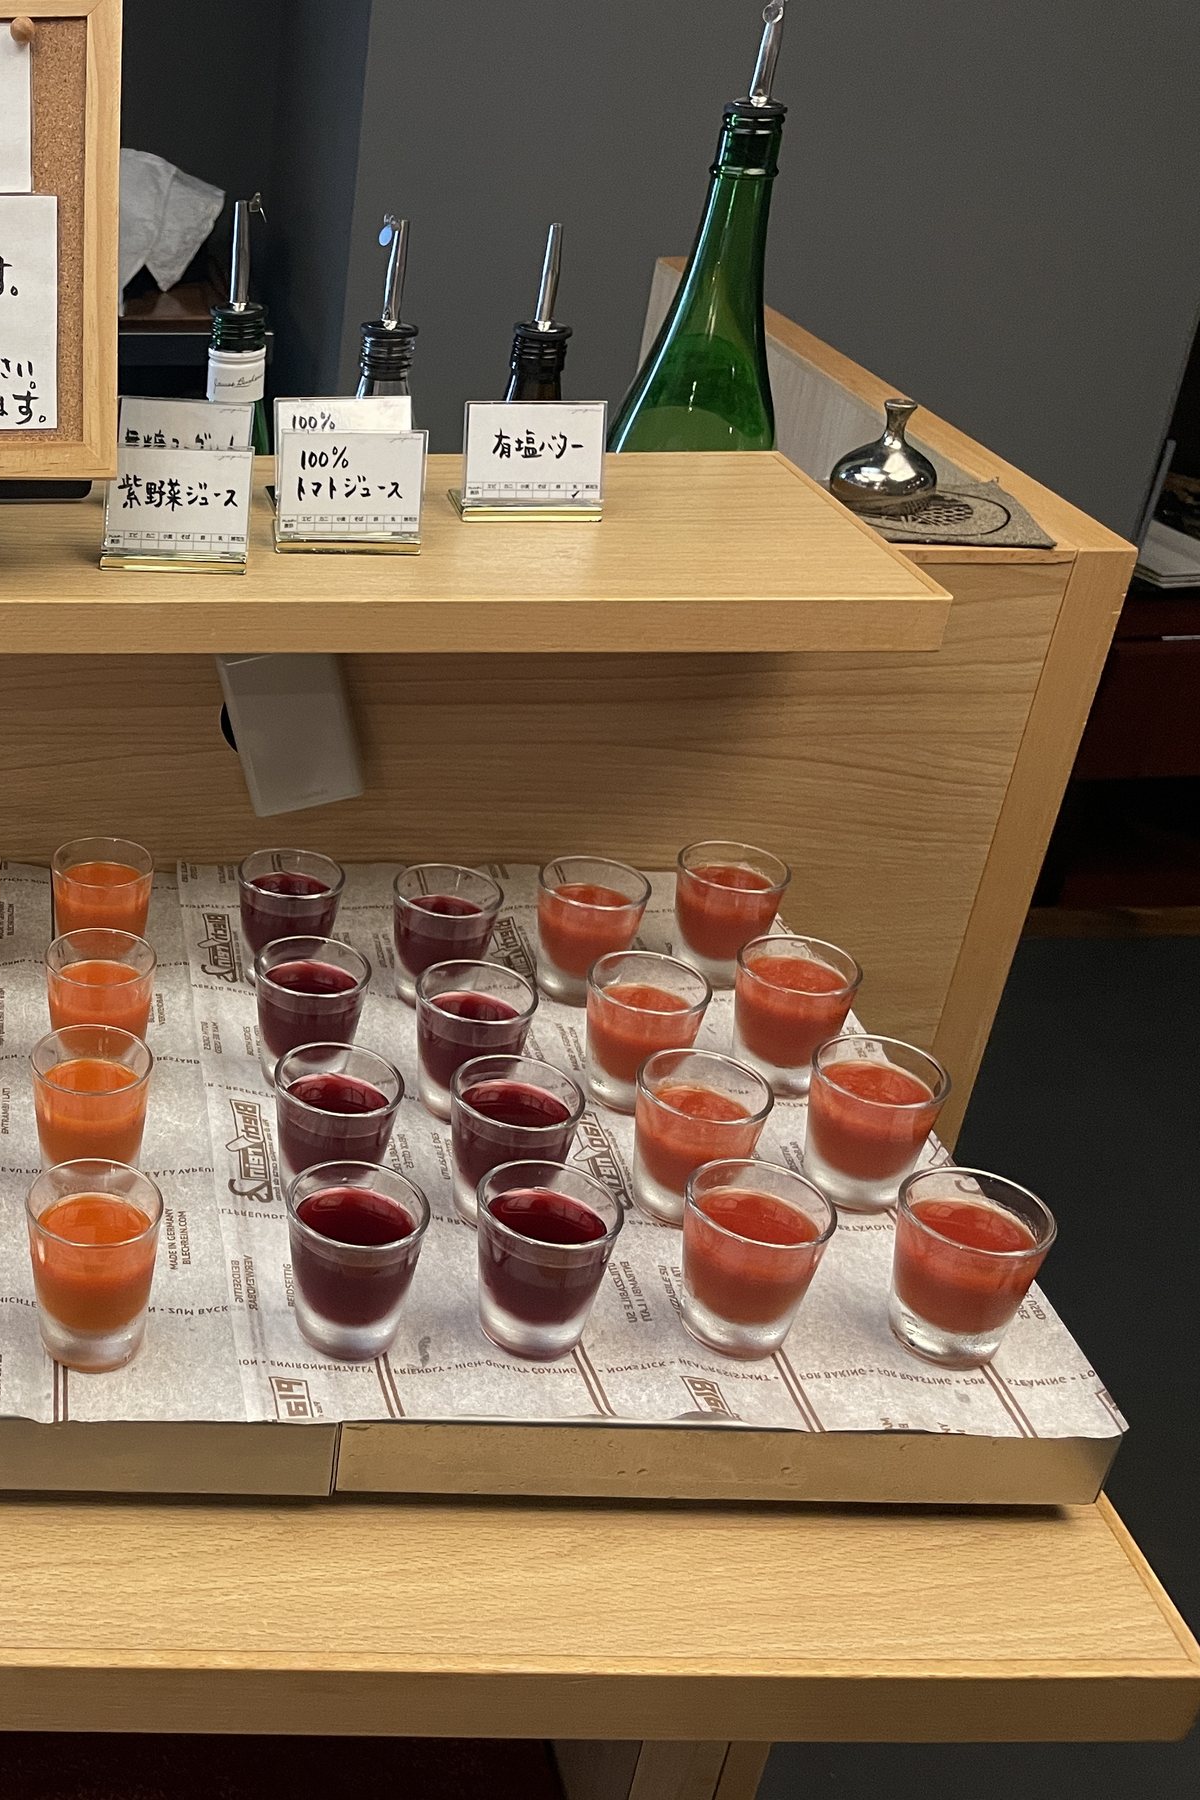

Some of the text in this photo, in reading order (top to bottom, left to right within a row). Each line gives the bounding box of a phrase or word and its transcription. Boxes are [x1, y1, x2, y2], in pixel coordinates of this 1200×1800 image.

[292, 412, 336, 429] 100%
[301, 446, 349, 470] 100%
[492, 427, 583, 459] 有塩バター
[117, 474, 238, 512] 紫野菜ジュース
[297, 476, 403, 501] トマトジュース
[164, 1208, 178, 1270] MADE IN GERMANY
[177, 1211, 191, 1265] BLECHREIN.COM
